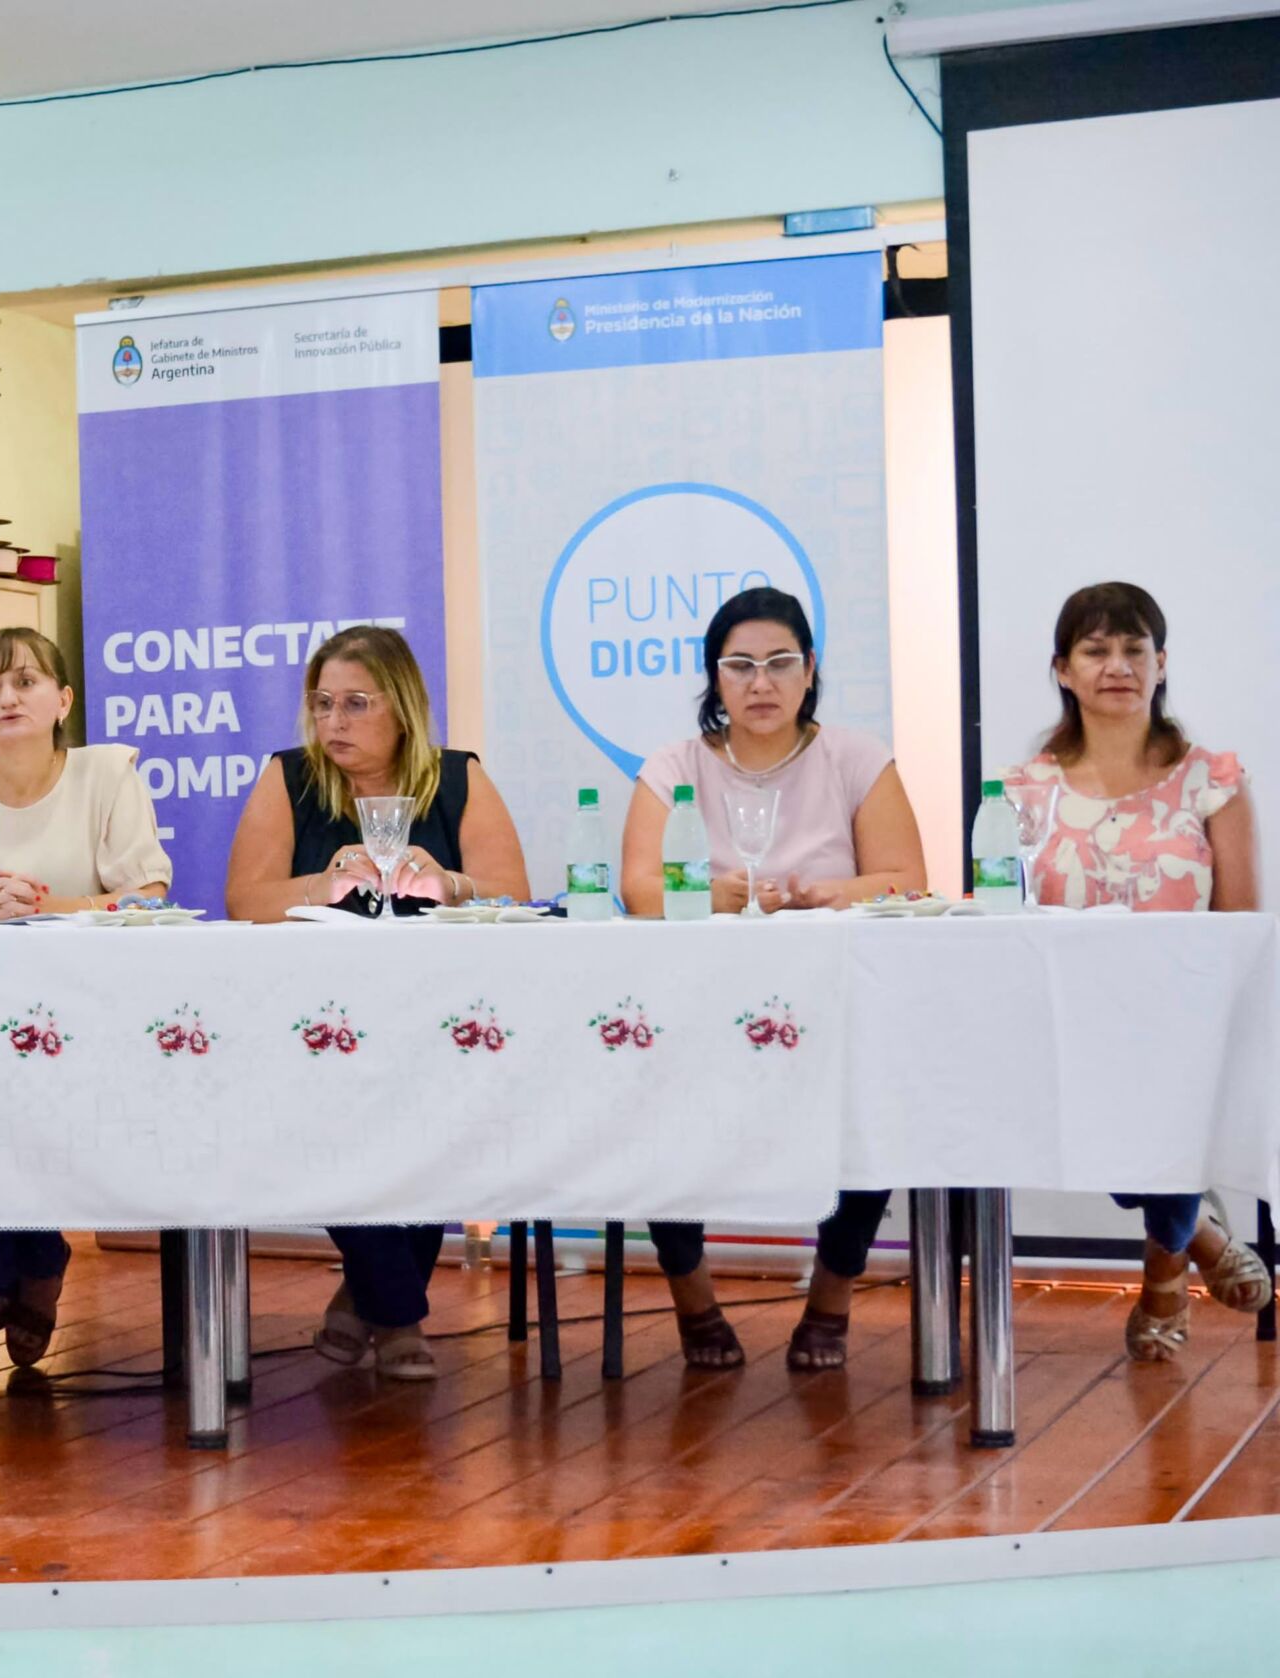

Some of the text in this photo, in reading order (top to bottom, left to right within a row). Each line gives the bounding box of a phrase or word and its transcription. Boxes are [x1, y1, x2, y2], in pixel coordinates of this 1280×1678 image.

[584, 291, 774, 317] Ministerio de Modernización
[584, 304, 802, 334] Presidencia de la Nación
[150, 336, 204, 352] Jefatura de
[294, 326, 368, 343] Secretaría de
[151, 346, 259, 364] Gabinete de Ministros
[294, 338, 402, 358] Innovación Pública
[151, 364, 215, 382] Argentina
[103, 616, 406, 674] CONECTA
[105, 690, 241, 738] PARA
